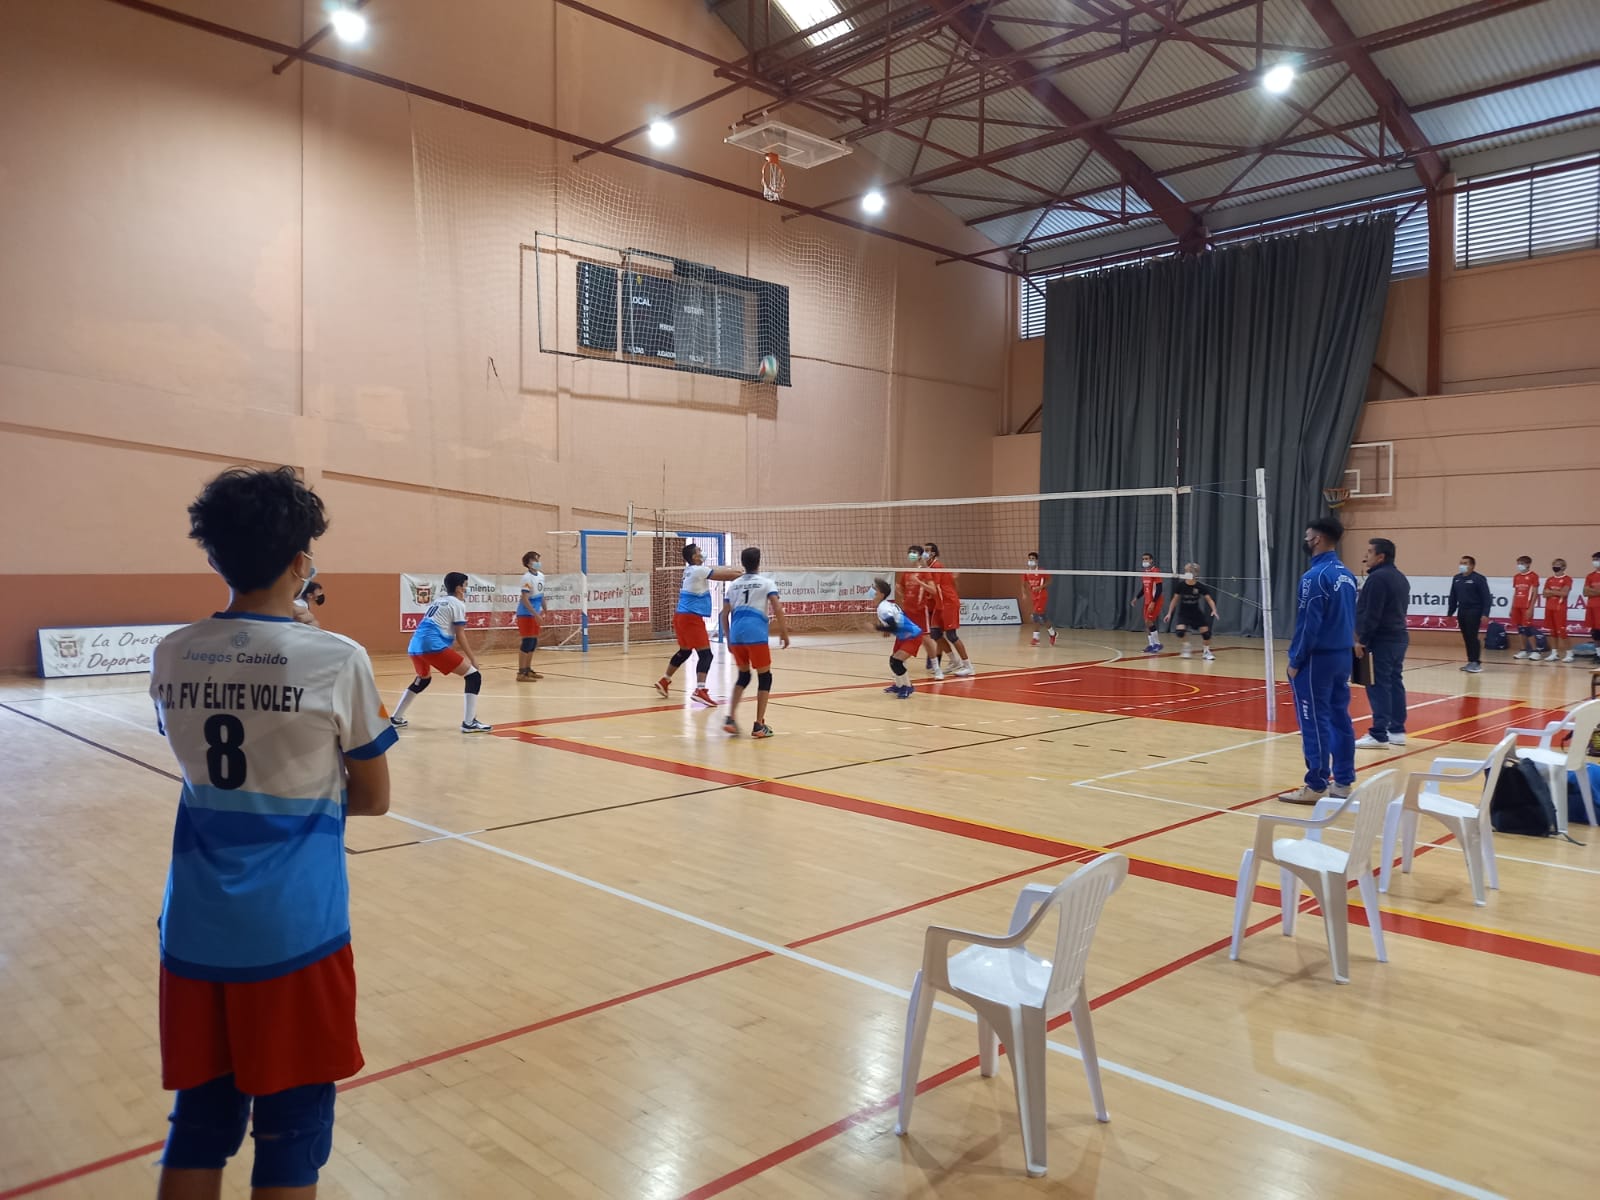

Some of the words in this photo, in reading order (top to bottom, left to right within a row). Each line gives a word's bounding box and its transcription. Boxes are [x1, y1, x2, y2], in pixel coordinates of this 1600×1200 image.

[742, 590, 749, 604] 1
[91, 633, 110, 648] La
[87, 653, 151, 672] Deporte
[183, 650, 232, 664] Juegos
[236, 652, 288, 665] Cabildo
[180, 682, 199, 710] FV
[204, 676, 246, 710] ÉLITE
[251, 684, 304, 712] VOLEY
[204, 713, 247, 790] 8
